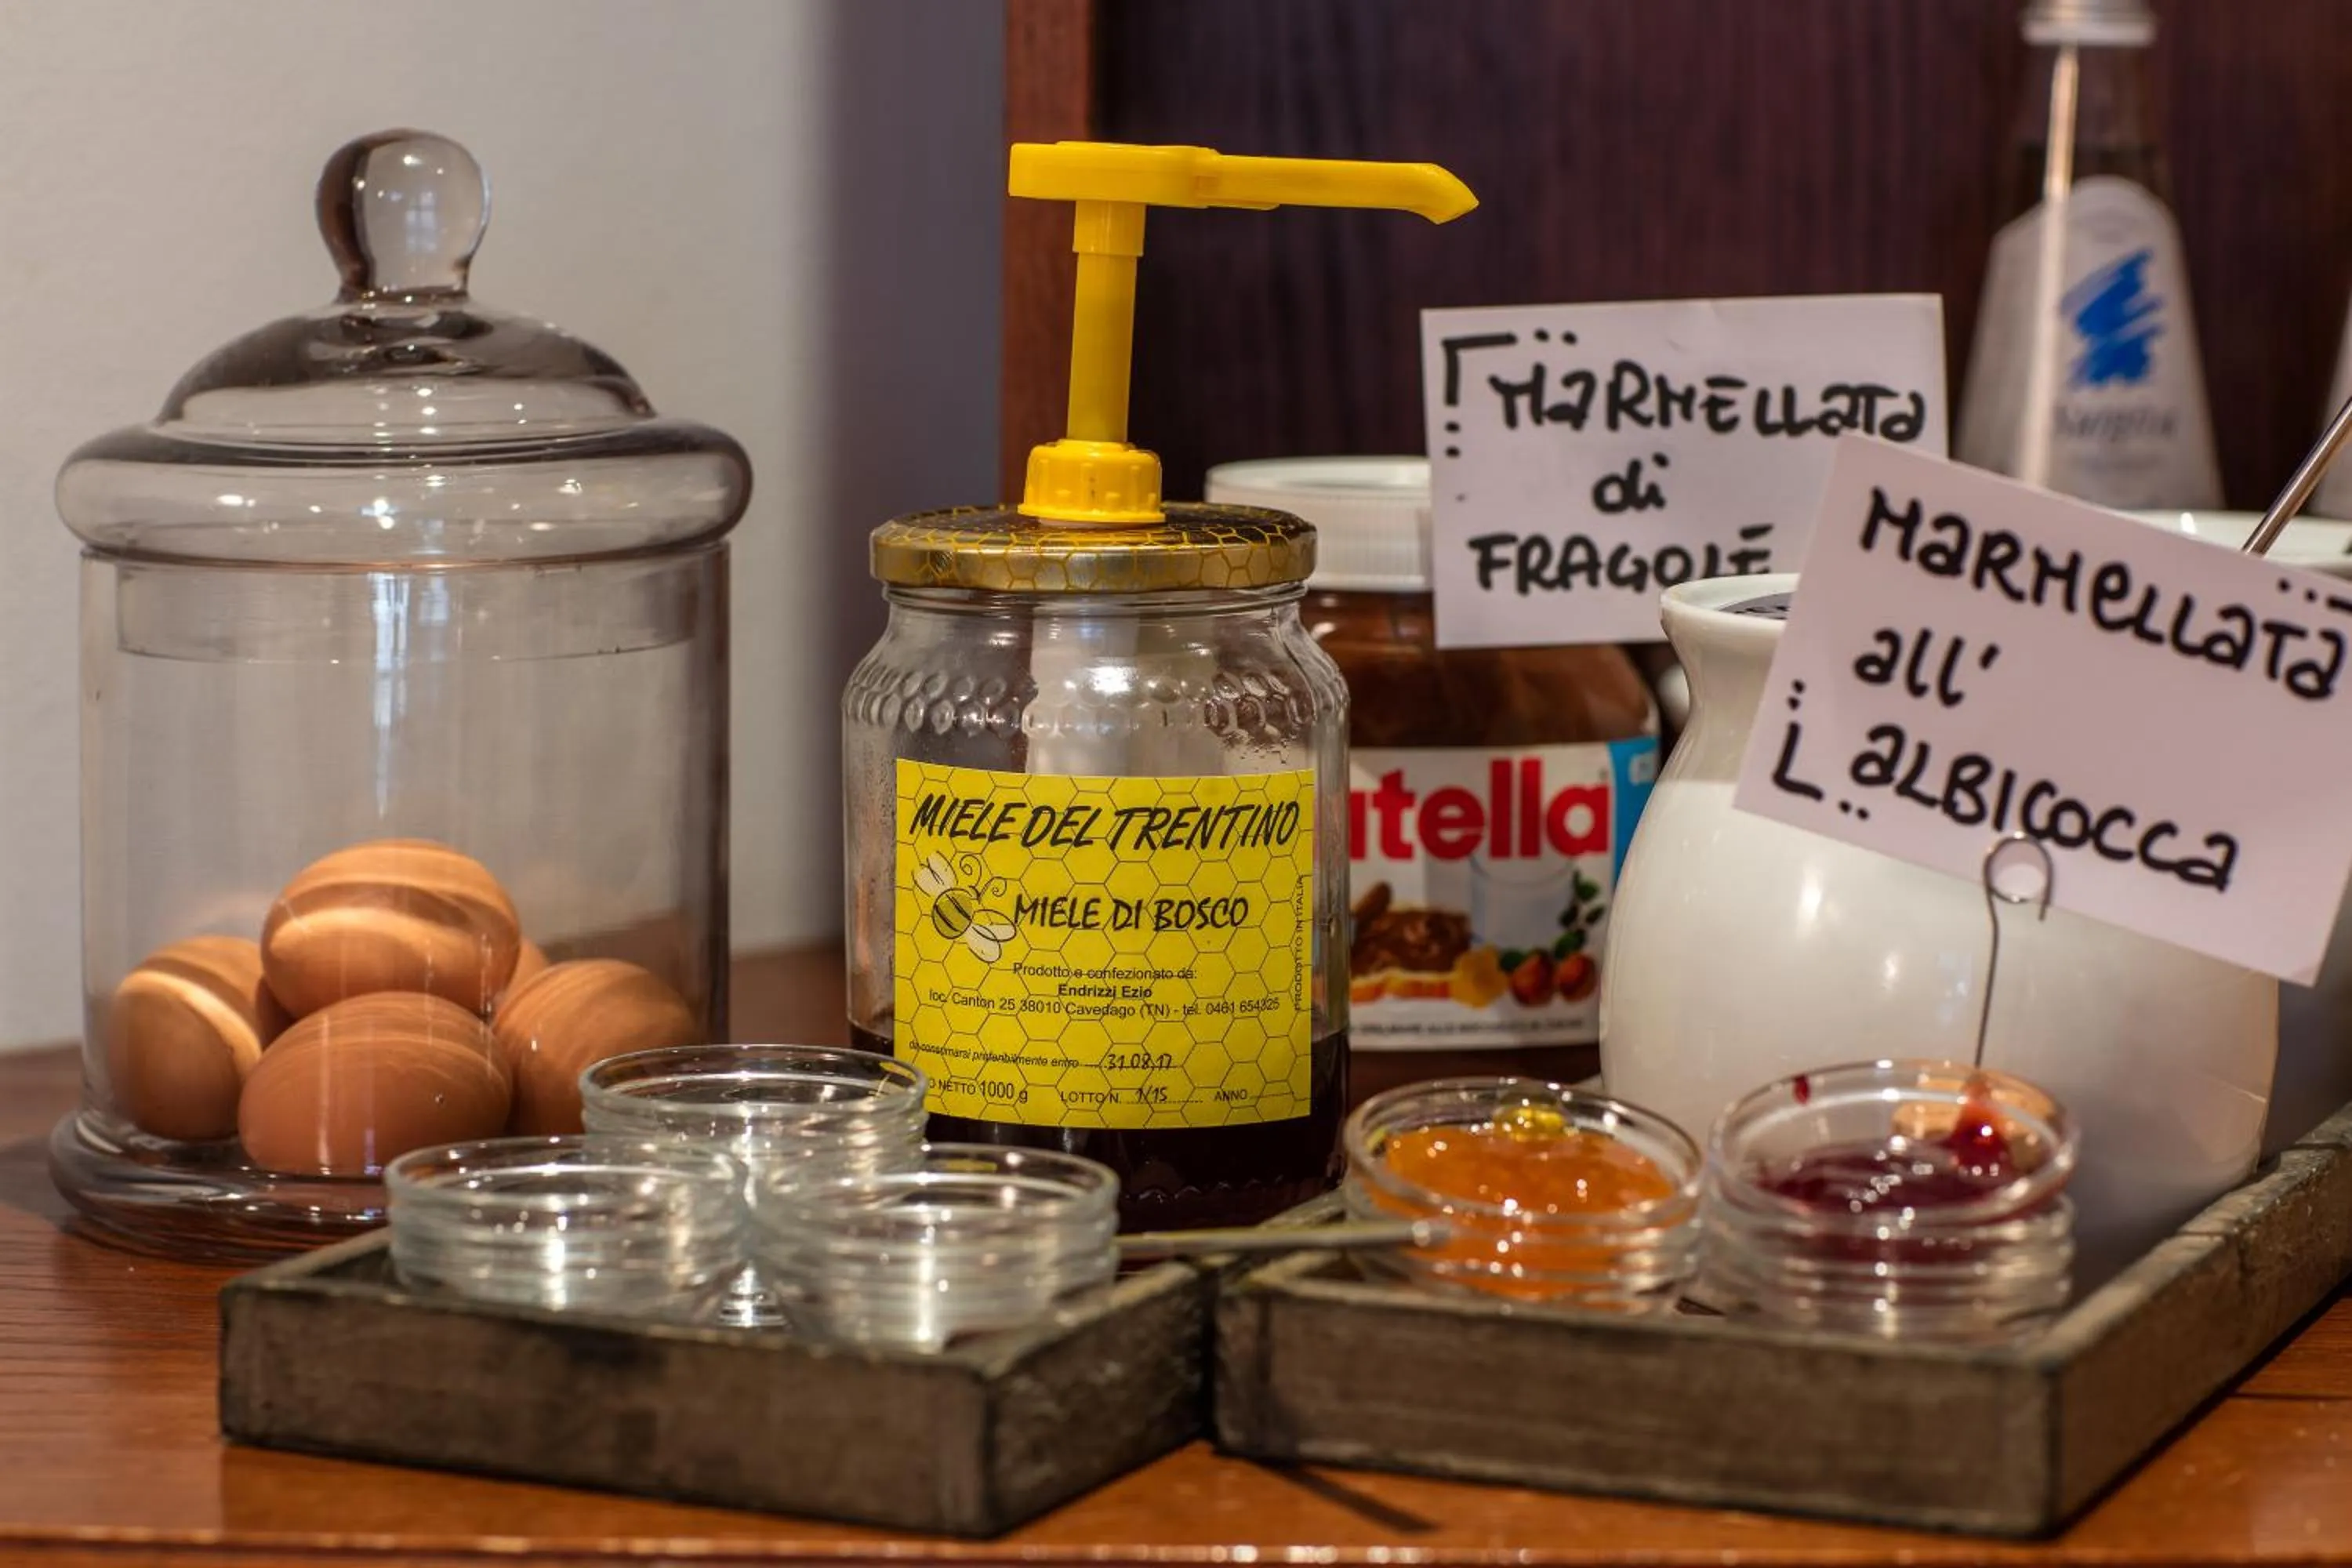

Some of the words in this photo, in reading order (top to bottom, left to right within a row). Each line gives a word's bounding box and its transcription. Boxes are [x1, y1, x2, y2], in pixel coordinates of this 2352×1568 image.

[1592, 452, 1670, 514] di
[1853, 626, 2000, 707] all'
[909, 793, 1027, 843] MIELE
[1022, 805, 1102, 848] DEL
[1109, 800, 1300, 851] TRENTINO
[1014, 894, 1101, 929] MIELE
[1112, 898, 1144, 931] DI
[1153, 896, 1249, 931] BOSCO
[1013, 963, 1070, 978] Prodotto
[1074, 970, 1083, 979] e
[1087, 967, 1174, 980] confezionato
[1294, 937, 1304, 1011] PRODOTTO
[1058, 984, 1117, 999] Endrizzi
[1121, 985, 1153, 998] Ezio
[951, 993, 995, 1010] Canton
[1000, 998, 1015, 1011] 25
[1019, 1000, 1061, 1014] 38010
[1065, 1003, 1135, 1018] Cavedago
[1139, 1004, 1171, 1019] (TN)
[1205, 1002, 1236, 1016] 0461
[938, 1080, 976, 1095] NETTO
[980, 1080, 1014, 1099] 1000
[1019, 1091, 1029, 1104] g
[1060, 1091, 1106, 1104] LOTTO
[1214, 1089, 1248, 1102] ANNO
